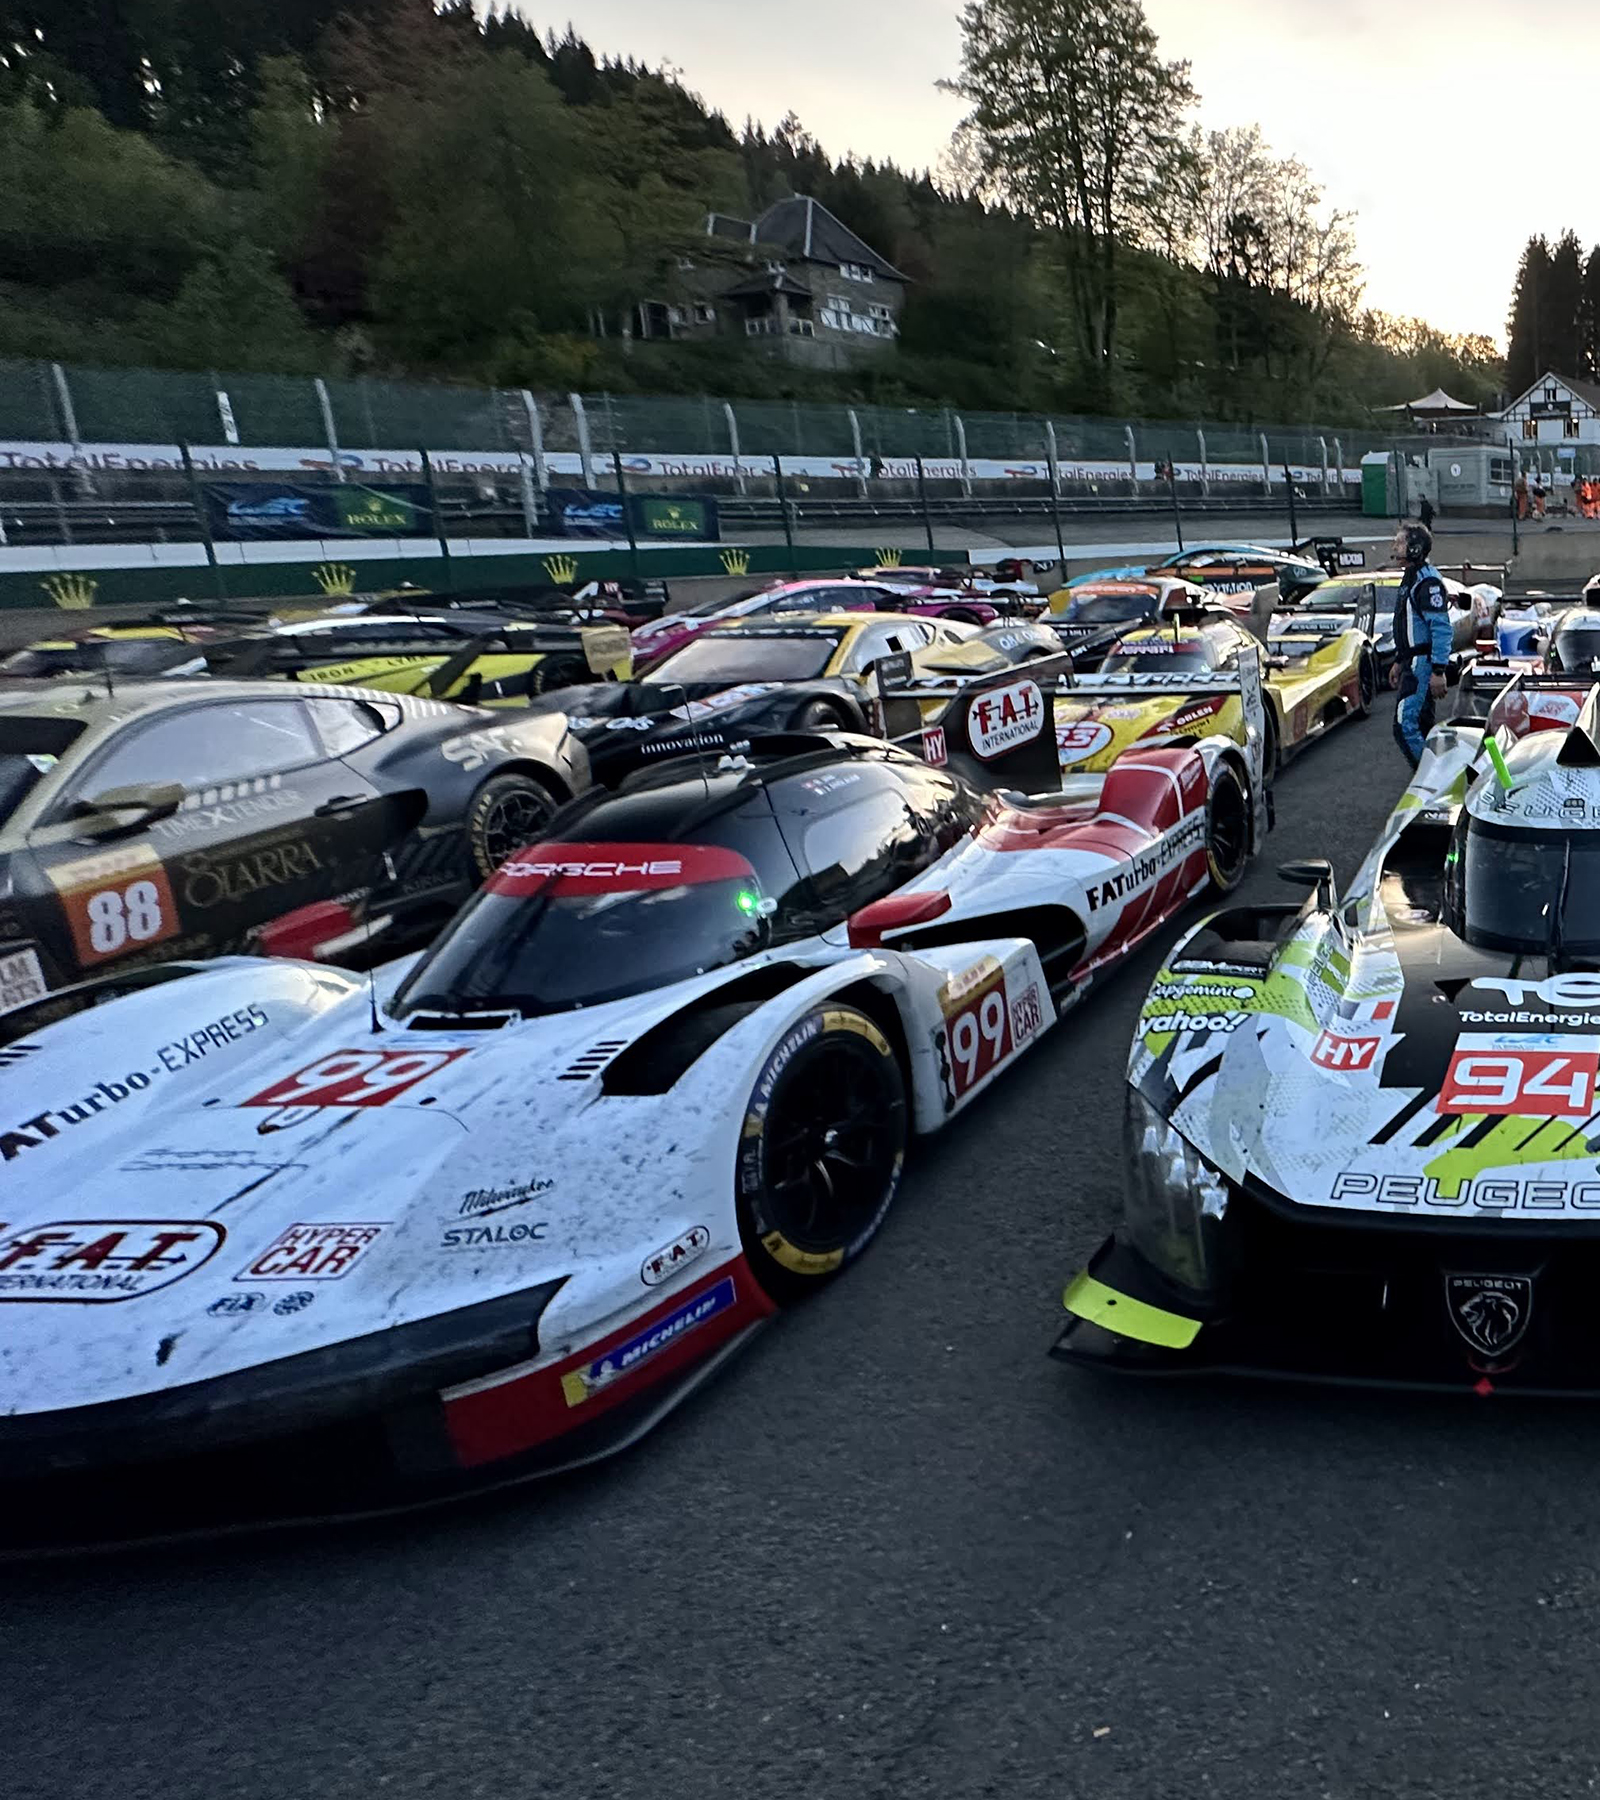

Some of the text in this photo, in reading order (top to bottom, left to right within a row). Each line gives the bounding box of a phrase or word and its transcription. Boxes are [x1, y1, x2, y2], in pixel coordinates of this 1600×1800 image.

[309, 667, 356, 682] IRON
[641, 733, 725, 755] innovation
[925, 733, 944, 764] HY
[981, 719, 1039, 752] INTERNATIONAL
[87, 880, 162, 953] 88
[952, 990, 1005, 1086] 99
[1015, 1006, 1041, 1040] CAR
[1138, 1009, 1250, 1040] yahoo!
[760, 1018, 818, 1099] MICHELIN
[1315, 1036, 1376, 1066] HY
[266, 1052, 452, 1103] 99
[1447, 1056, 1590, 1108] 94
[268, 1228, 381, 1245] HYPER
[441, 1222, 549, 1248] STALOC
[250, 1246, 361, 1276] CAR
[1453, 1279, 1525, 1291] PEUGEOT
[621, 1296, 717, 1367] MICHELIN
